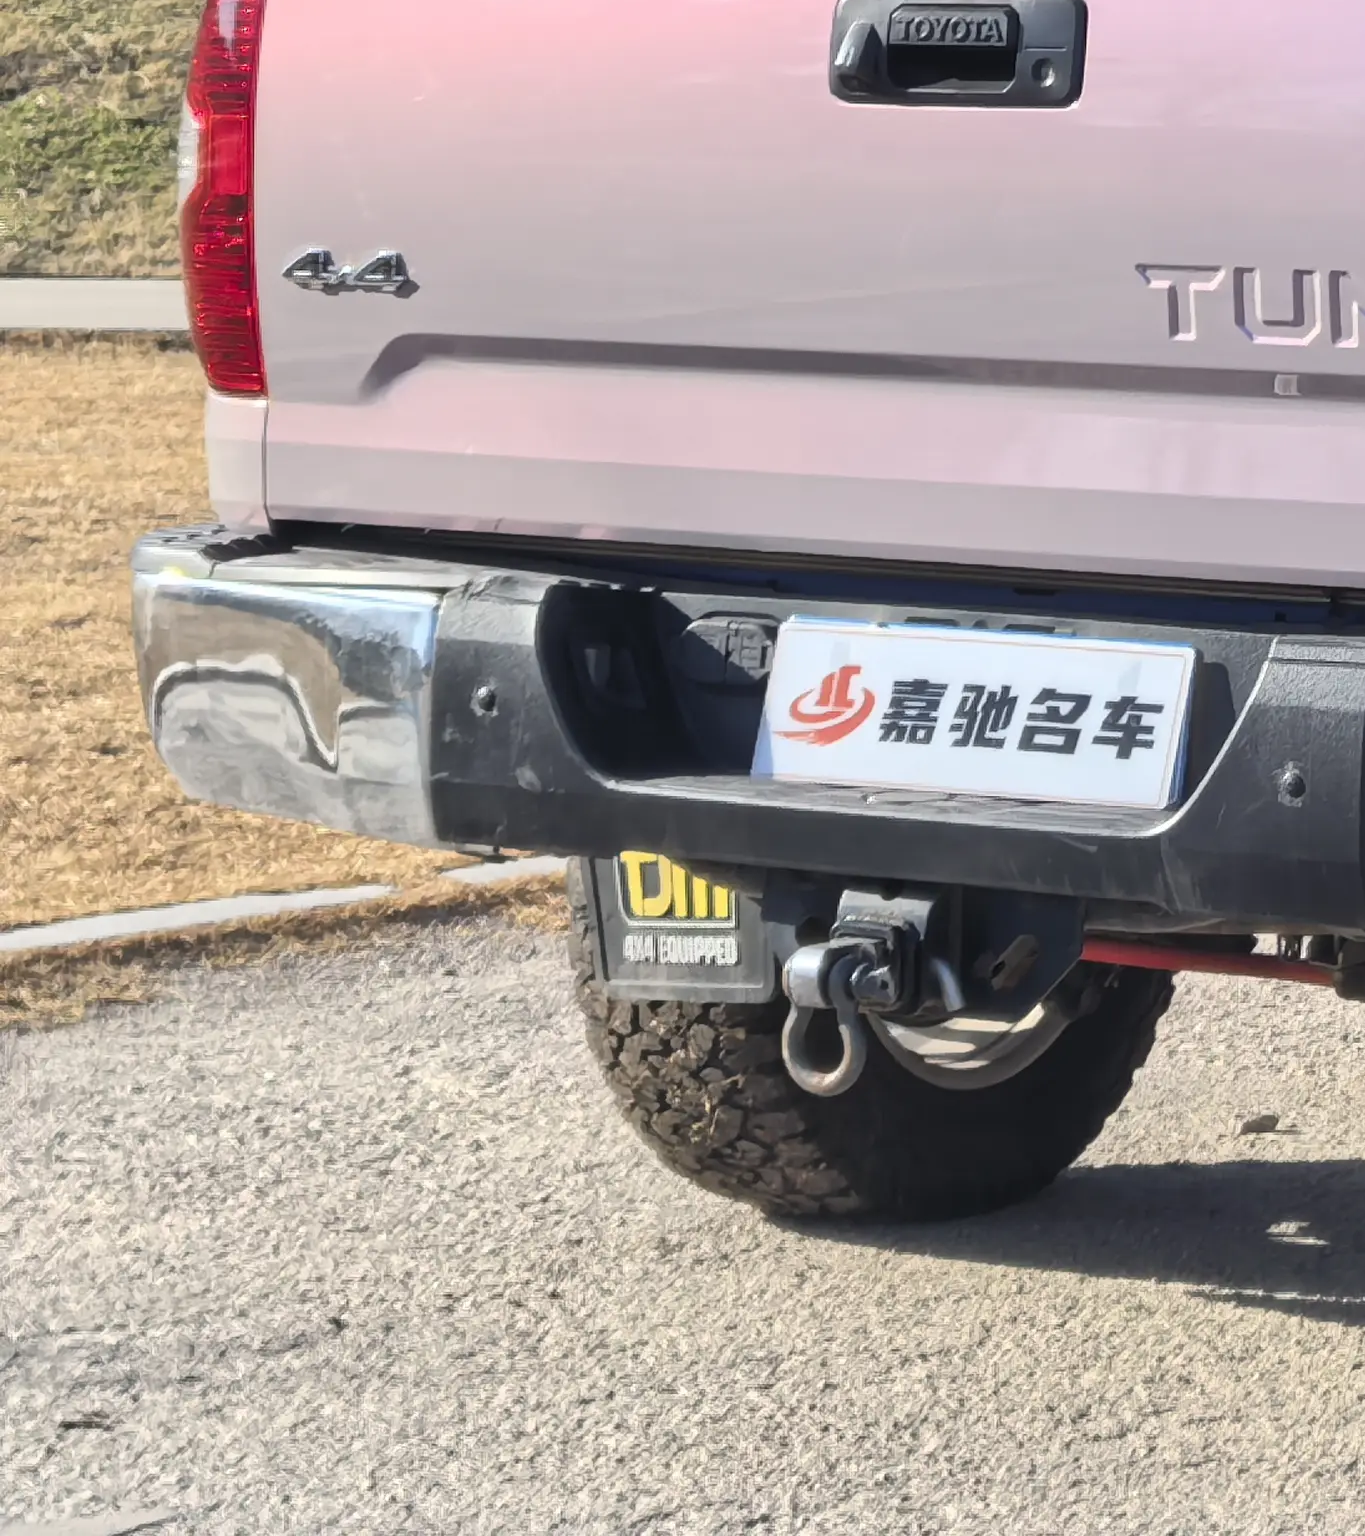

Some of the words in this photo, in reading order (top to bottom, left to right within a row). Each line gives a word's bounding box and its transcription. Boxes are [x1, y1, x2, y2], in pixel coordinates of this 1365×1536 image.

[897, 15, 1003, 43] TOYOTA
[879, 678, 1164, 760] 嘉驰名车
